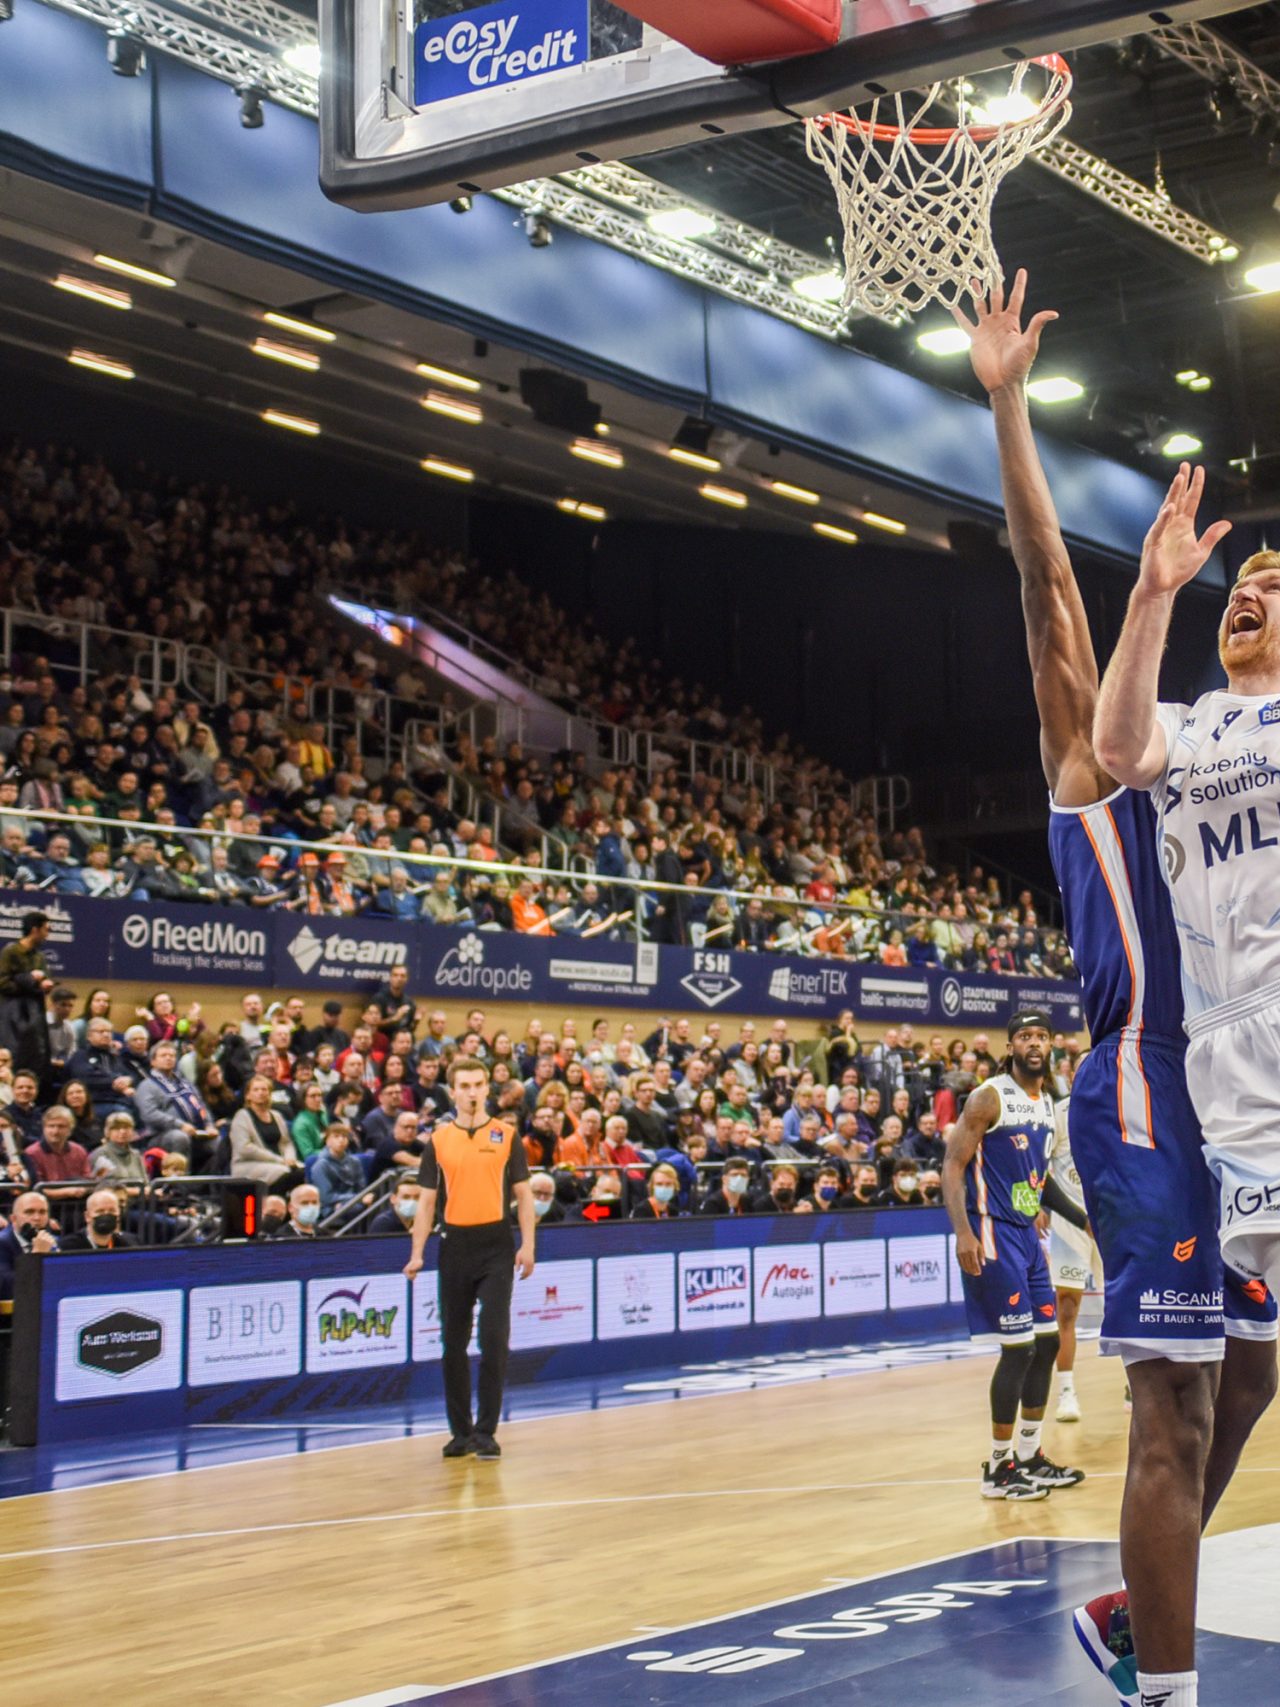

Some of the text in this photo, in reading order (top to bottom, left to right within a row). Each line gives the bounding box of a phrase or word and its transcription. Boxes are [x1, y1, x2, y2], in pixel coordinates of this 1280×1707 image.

[468, 29, 577, 86] Credit
[1190, 748, 1268, 778] koenig
[152, 917, 265, 956] FleetMon
[324, 933, 408, 965] team
[153, 952, 265, 971] Tracking the Seven Seas
[319, 964, 345, 977] bau
[693, 952, 730, 974] FSH
[790, 968, 848, 995] enerTEK
[861, 992, 884, 1007] baltic
[962, 986, 1009, 1001] STADTWERKE
[962, 999, 997, 1013] ROSTOCK
[1017, 1103, 1035, 1114] OSPA
[1044, 1132, 1053, 1159] 0
[895, 1261, 940, 1279] MONTRA
[772, 1285, 814, 1300] Autoglas
[1139, 1313, 1161, 1323] ERST
[1164, 1314, 1195, 1324] BAUEN
[773, 1579, 1048, 1640] OSPA
